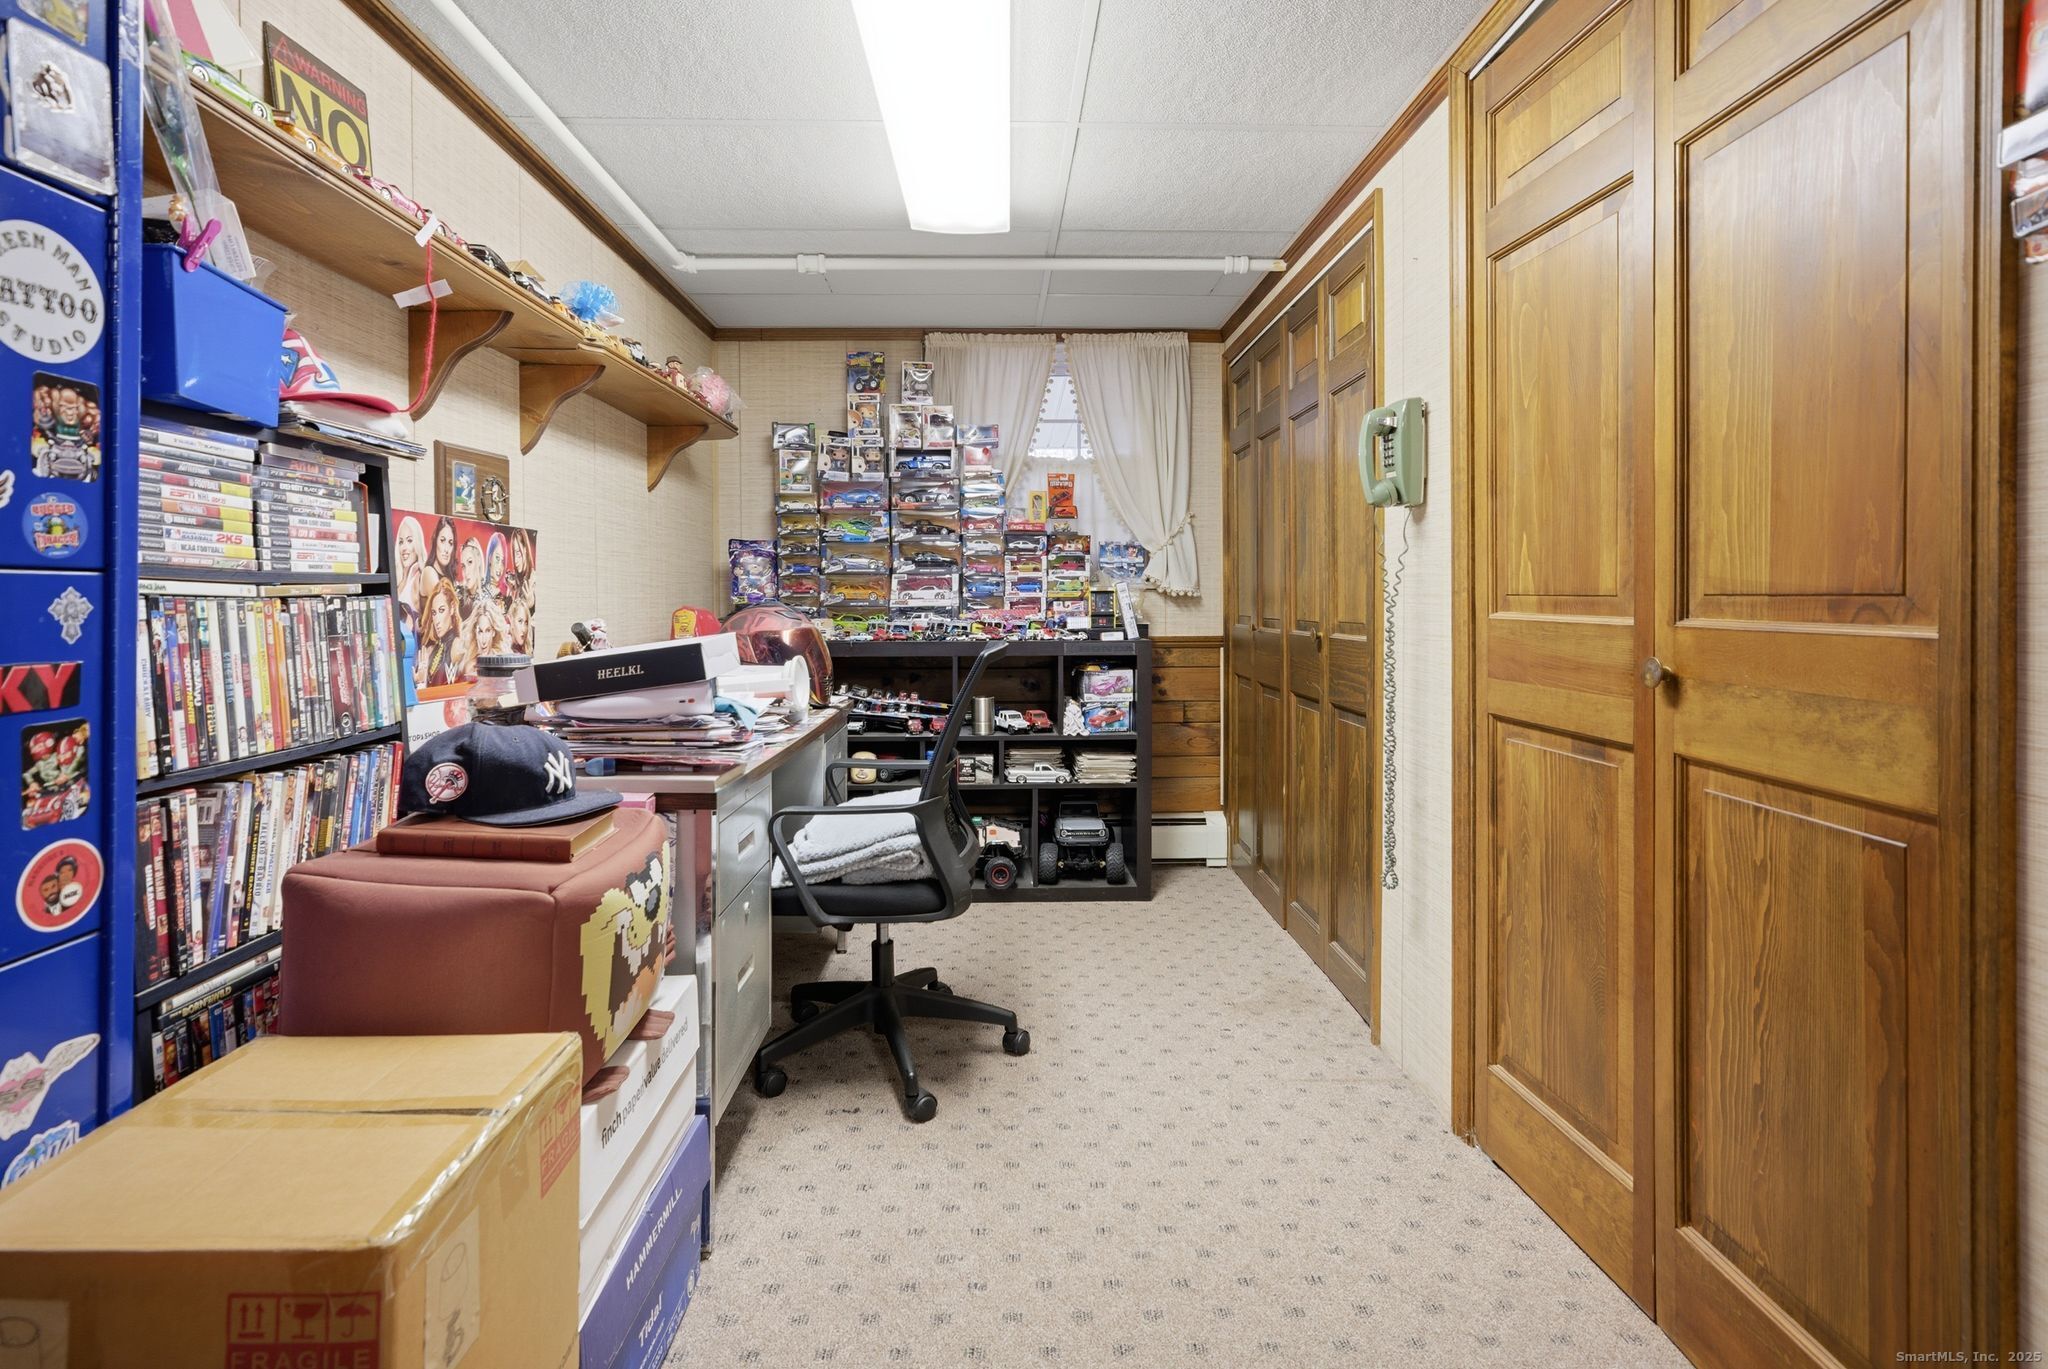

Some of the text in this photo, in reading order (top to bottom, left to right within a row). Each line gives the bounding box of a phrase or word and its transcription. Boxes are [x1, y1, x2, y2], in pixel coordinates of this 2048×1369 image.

[296, 57, 366, 114] WARNING
[280, 70, 366, 168] NO
[0, 229, 45, 257] EEN
[0, 276, 98, 324] ATTOO
[215, 533, 243, 545] 2K5
[0, 663, 77, 713] KY
[183, 657, 196, 725] BOUNTY HUNTER
[597, 664, 645, 680] HEELKL
[224, 855, 234, 885] honey
[250, 833, 259, 874] HUNGER
[144, 864, 156, 930] UNLEASHED
[245, 875, 254, 910] GAMES
[601, 1110, 622, 1149] finch
[661, 1017, 689, 1063] delivered
[626, 1187, 683, 1291] HAMMERMILL
[638, 1290, 664, 1348] Tidal
[231, 1349, 371, 1369] FRAGILE
